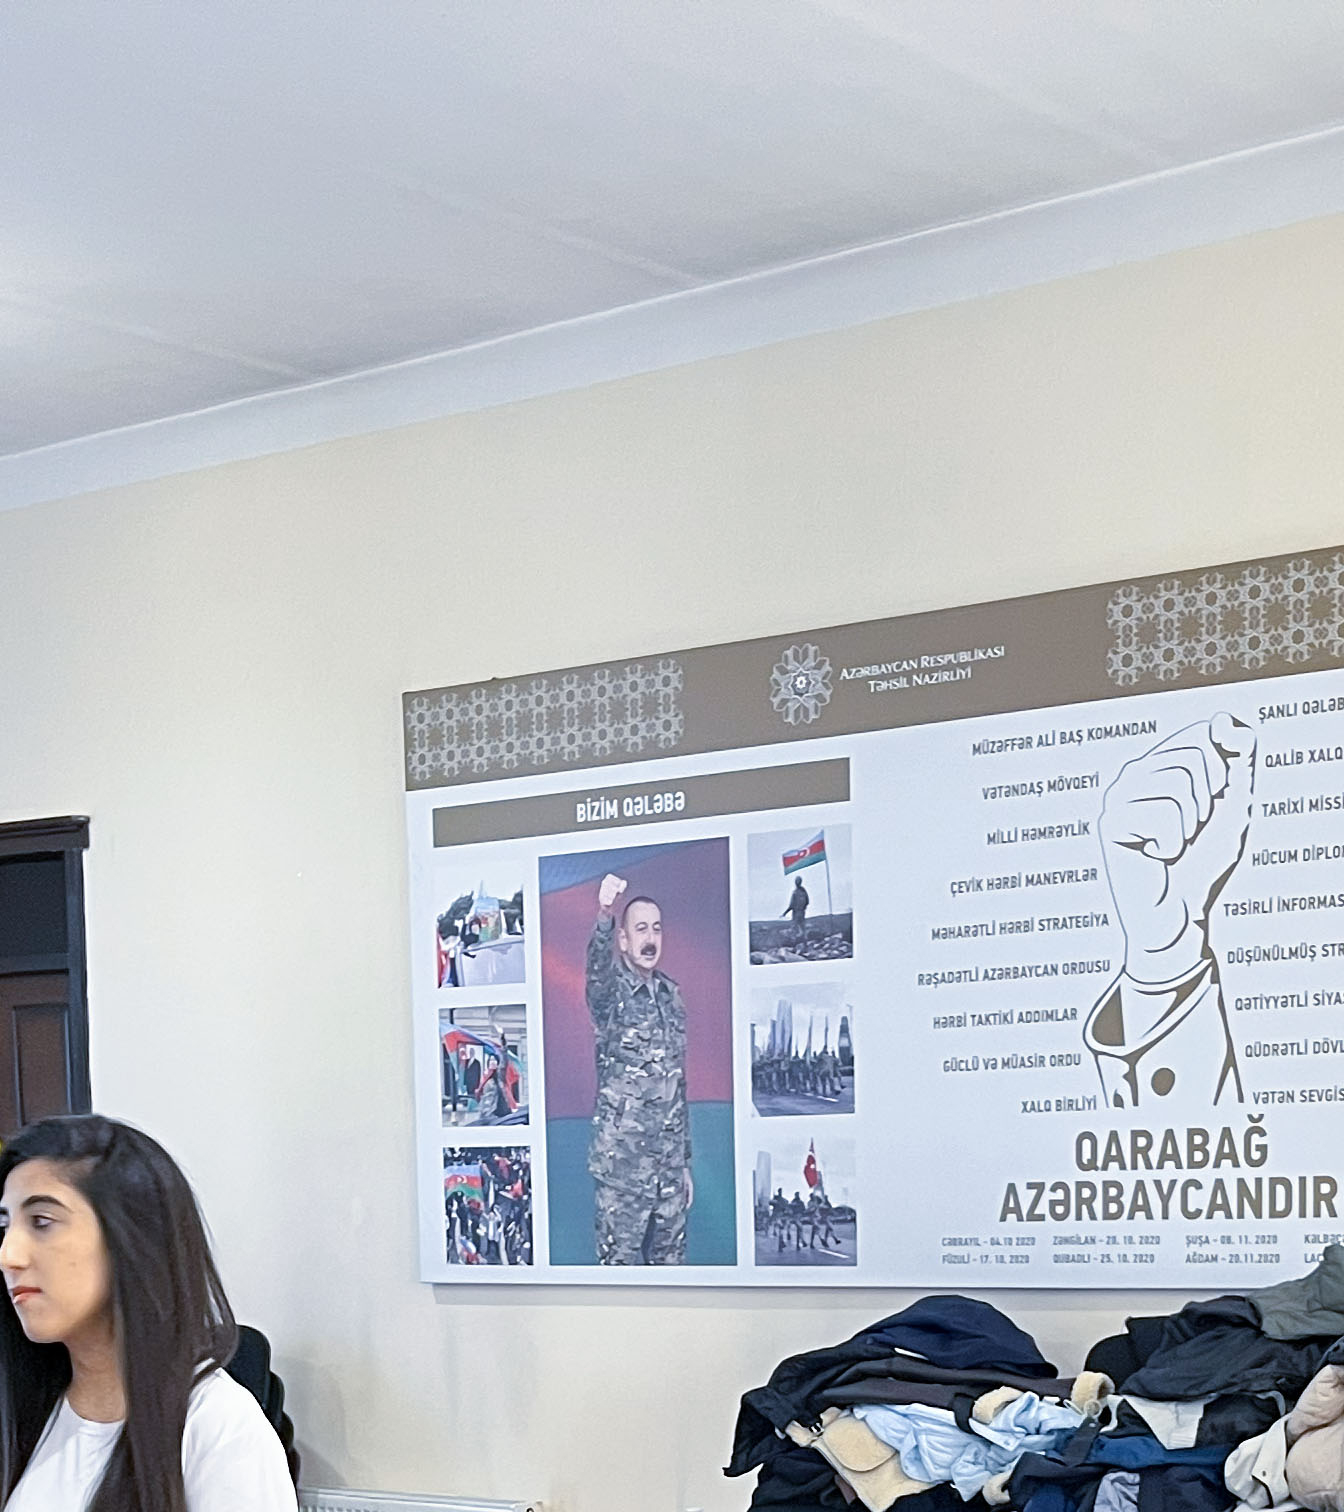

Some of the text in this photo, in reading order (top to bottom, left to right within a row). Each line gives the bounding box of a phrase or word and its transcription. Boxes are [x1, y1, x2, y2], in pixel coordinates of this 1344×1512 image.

[1258, 702, 1298, 725] ŞANLI
[972, 719, 1157, 756] MÜZƏFFƏR ALİ BAŞ KOMANDAN
[1265, 746, 1344, 768] QALİB XALQ
[982, 771, 1100, 800] VƏTƏNDAŞ MÖVQEYİ
[576, 791, 686, 823] BİZİM QƏLƏBƏ
[1261, 796, 1304, 818] TARİXİ
[986, 819, 1090, 846] MİLLİ HƏMRƏYLİK
[1251, 848, 1298, 867] HÜCUM
[950, 867, 1098, 898] ÇEVİK HƏRBİ MANEVRLƏR
[1223, 896, 1273, 917] TƏSİRLİ
[931, 911, 1110, 941] MƏHARƏTLİ HƏRBİ STRATEGİYA
[1227, 942, 1317, 966] DÜŞÜNÜLMÜŞ
[917, 959, 1111, 988] RƏŞADƏTLİ AZƏRBAYCAN ORDUSU
[1234, 990, 1309, 1012] QƏTİYYƏTLİ
[932, 1007, 1078, 1030] HƏRBİ TAKTİKİ ADDIMLAR
[1244, 1038, 1309, 1058] QÜDRƏTLİ
[943, 1052, 1082, 1073] GÜCLÜ VƏ MÜASİR ORDU
[1020, 1094, 1097, 1114] XALQ BİRLİYİ
[1252, 1089, 1295, 1105] VƏTƏN
[1075, 1113, 1268, 1172] QARABAĞ
